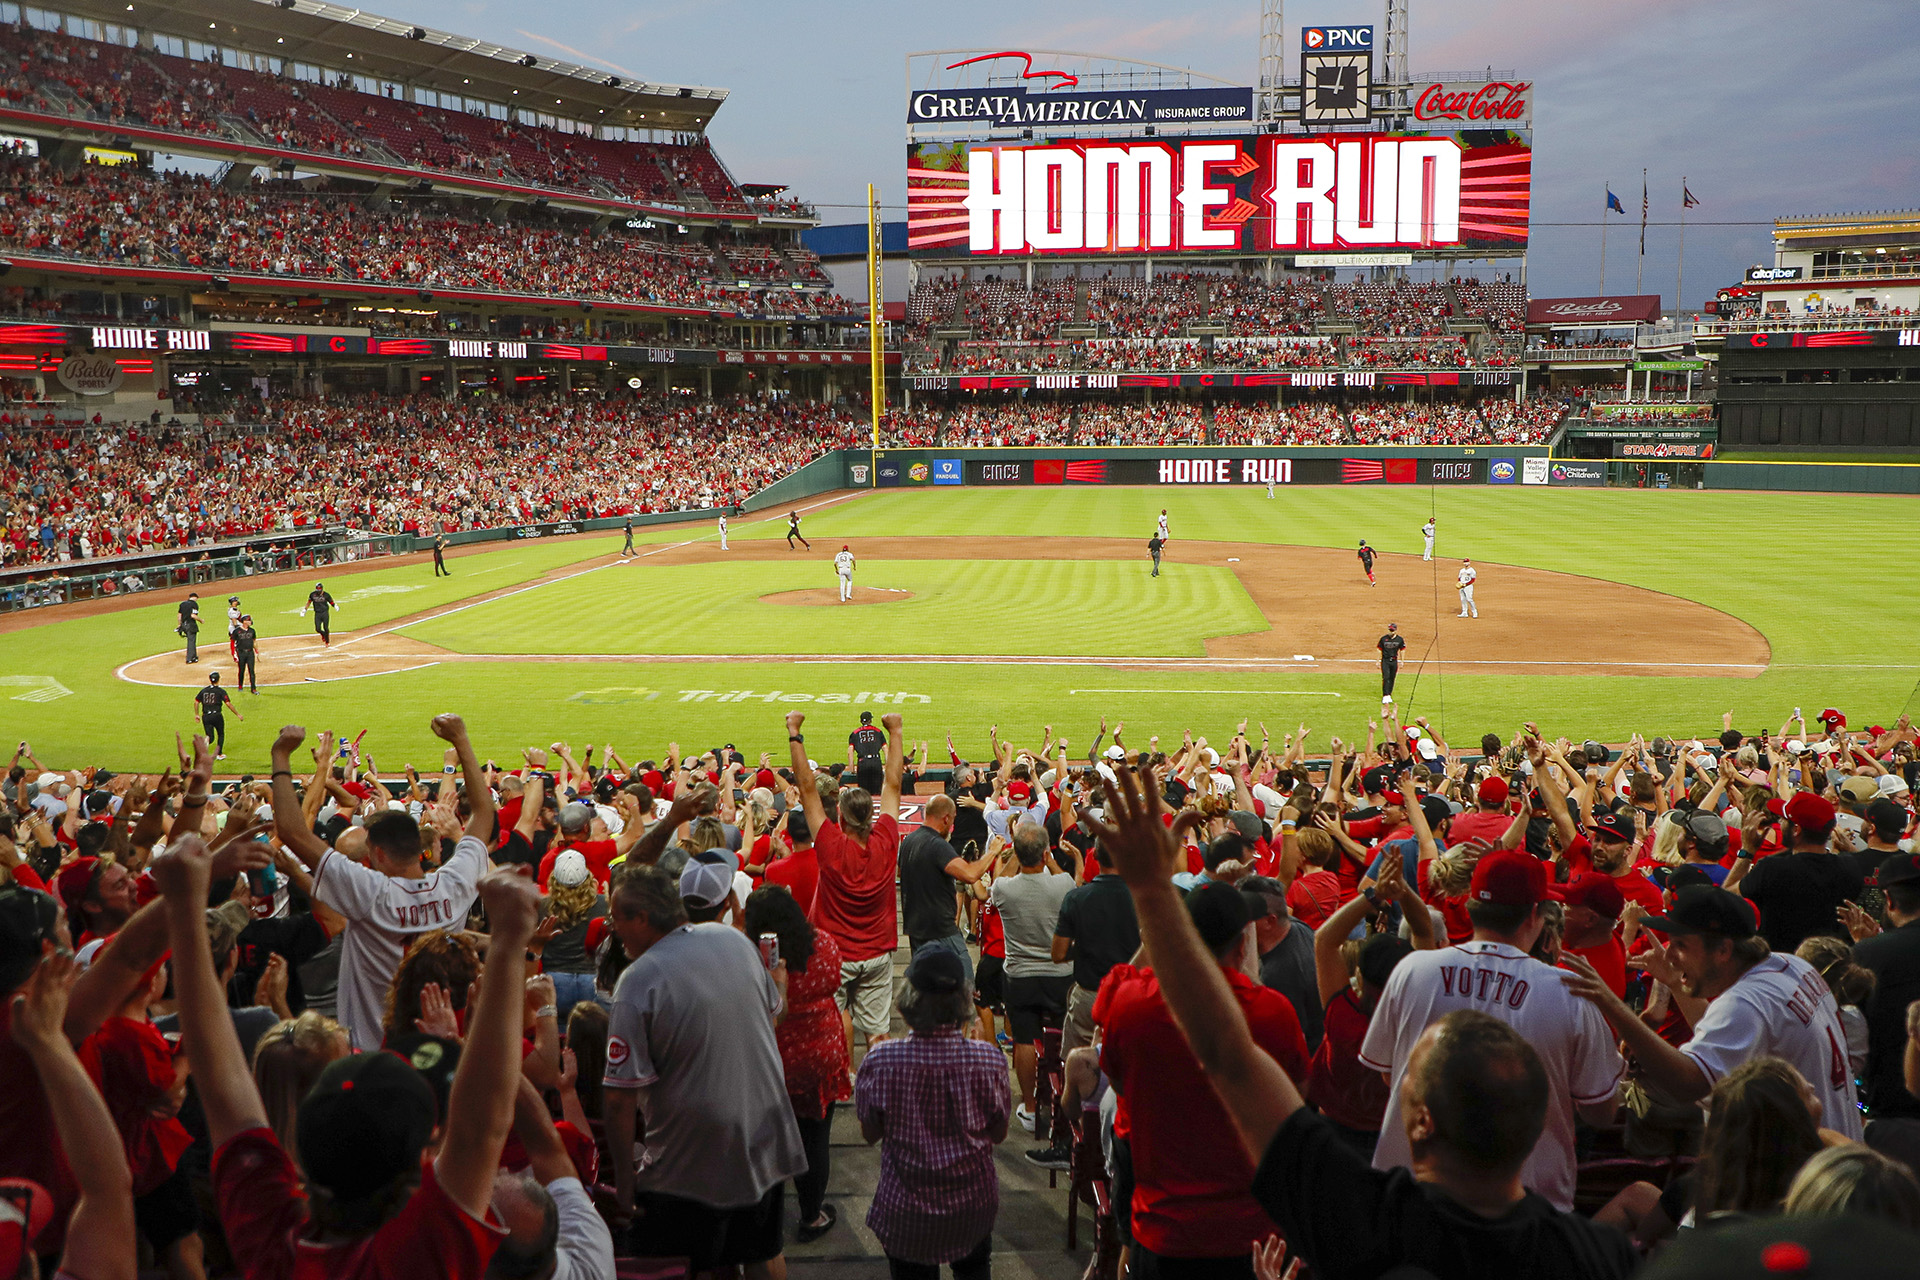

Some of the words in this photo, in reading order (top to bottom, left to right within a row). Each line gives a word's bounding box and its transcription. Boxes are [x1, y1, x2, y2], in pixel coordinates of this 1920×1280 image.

[1327, 28, 1371, 47] PNC
[1414, 82, 1533, 121] Coca-Cola
[999, 98, 1148, 124] AMERICAN
[1155, 107, 1207, 119] INSURANCE
[1212, 105, 1246, 118] GROUP
[961, 140, 1243, 251] HOME
[1261, 138, 1463, 249] RUN
[1337, 256, 1388, 264] ULTIMATE
[1389, 256, 1410, 264] JET
[1751, 268, 1797, 281] altafiber
[1546, 300, 1623, 315] Reds
[1720, 301, 1763, 312] TUNDRA
[91, 327, 160, 350] HOME
[167, 329, 211, 351] RUN
[448, 340, 493, 358] HOME
[498, 342, 528, 359] RUN
[648, 348, 676, 363] CINCY
[65, 358, 117, 384] Bally
[1473, 371, 1511, 386] CINCY
[78, 380, 106, 388] SPORTS
[914, 377, 948, 391] CINCY
[1035, 374, 1081, 389] HOME
[1086, 374, 1119, 389] RUN
[1290, 373, 1336, 387] HOME
[1344, 372, 1376, 386] RUN
[1464, 448, 1476, 456] 379
[1623, 444, 1655, 456] STAR
[1668, 444, 1698, 457] FIRE
[855, 470, 865, 479] 32
[983, 464, 1021, 480] CINCY
[1157, 458, 1233, 484] HOME
[1242, 458, 1293, 484] RUN
[1432, 463, 1473, 480] CINCY
[1527, 464, 1547, 473] Valley
[1567, 471, 1602, 479] Children's
[678, 690, 933, 704] TriHealth
[858, 730, 876, 744] 55
[396, 898, 454, 929] VOTTO
[1439, 965, 1532, 1012] VOTTO
